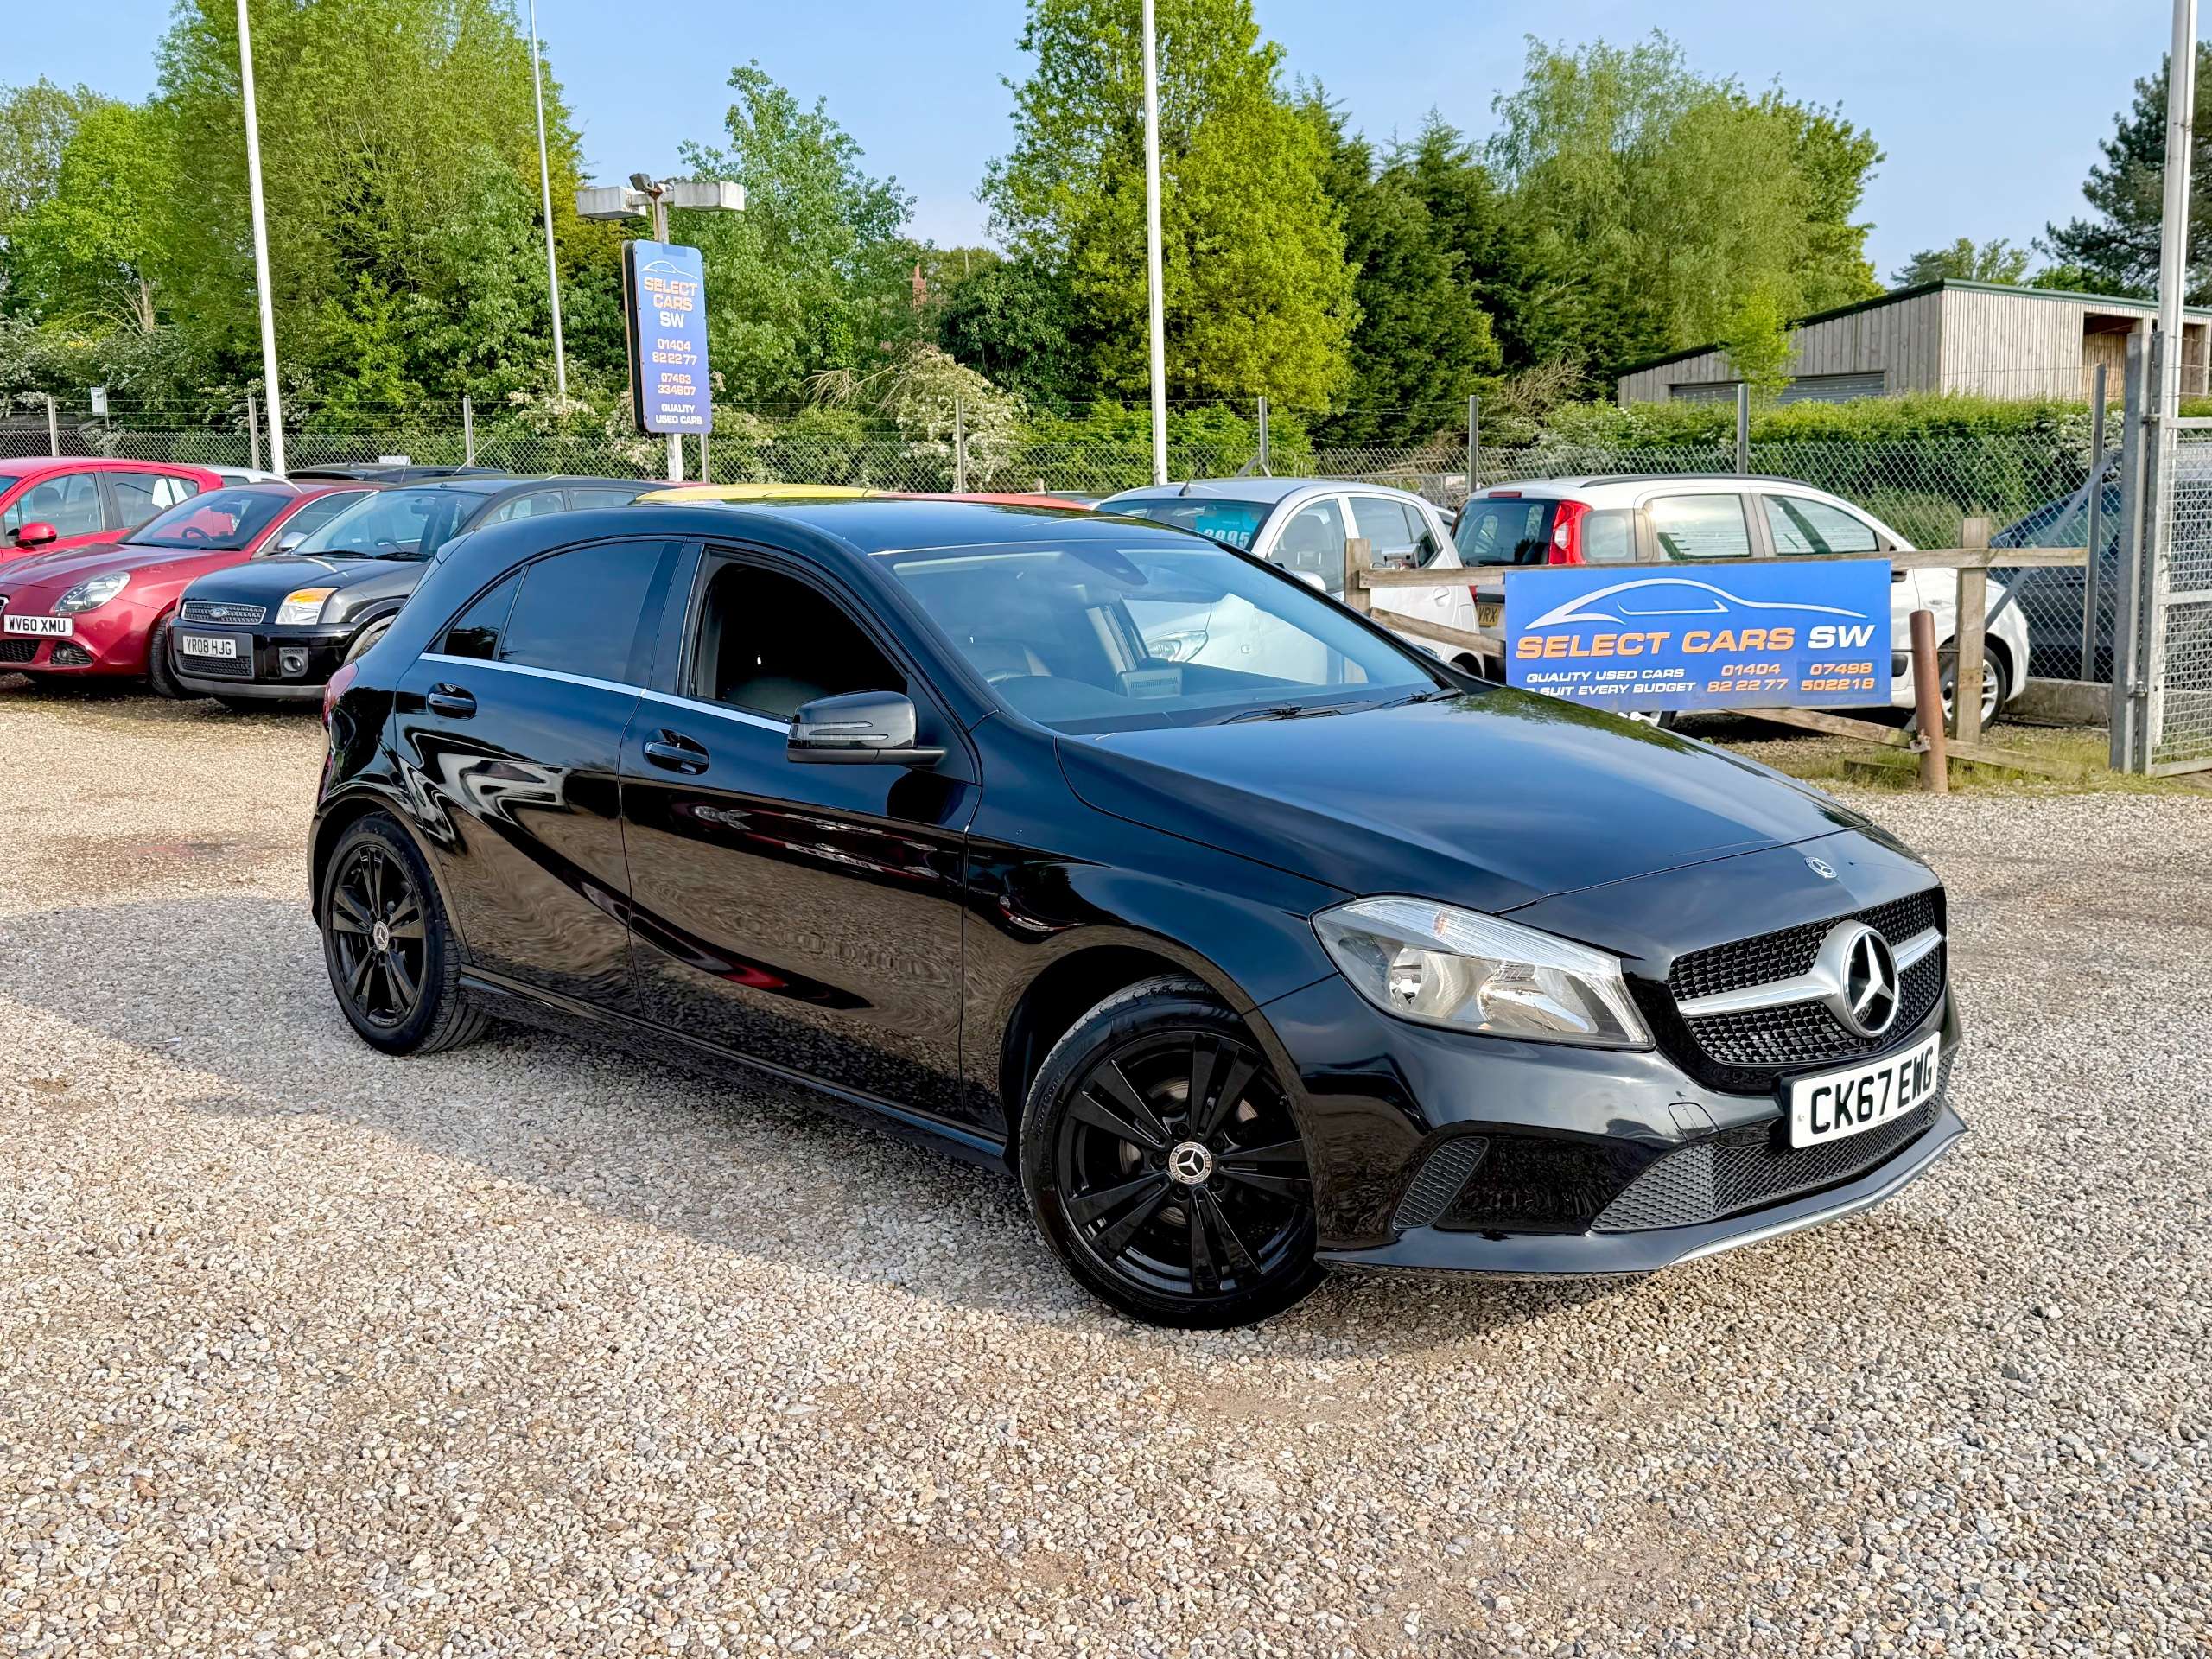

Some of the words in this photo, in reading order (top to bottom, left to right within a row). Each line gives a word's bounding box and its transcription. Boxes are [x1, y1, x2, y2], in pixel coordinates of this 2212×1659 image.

[644, 276, 698, 297] SELECT
[653, 294, 693, 312] CARS
[659, 310, 685, 328] SW
[657, 338, 692, 353] 01404
[660, 403, 696, 413] QUALITY
[655, 414, 679, 424] USED
[679, 415, 703, 425] CARS
[9, 616, 37, 632] WV60
[41, 619, 67, 632] XMU
[186, 638, 209, 653] YR08
[211, 640, 232, 656] HJG
[1516, 632, 1672, 659] SELECT
[1681, 627, 1796, 654] CARS
[1808, 624, 1876, 649] SW
[1526, 671, 1592, 683] QUALITY
[1595, 670, 1638, 682] USED
[1641, 668, 1686, 680] CARS
[1721, 663, 1782, 677] 01404
[1809, 662, 1873, 677] 07498
[1540, 685, 1575, 696] SUIT
[1578, 683, 1630, 696] EVERY
[1633, 682, 1697, 694] BUDGET
[1801, 677, 1876, 692] 502218
[1811, 1067, 1893, 1135] CK67
[1898, 1046, 1934, 1109] EWG
